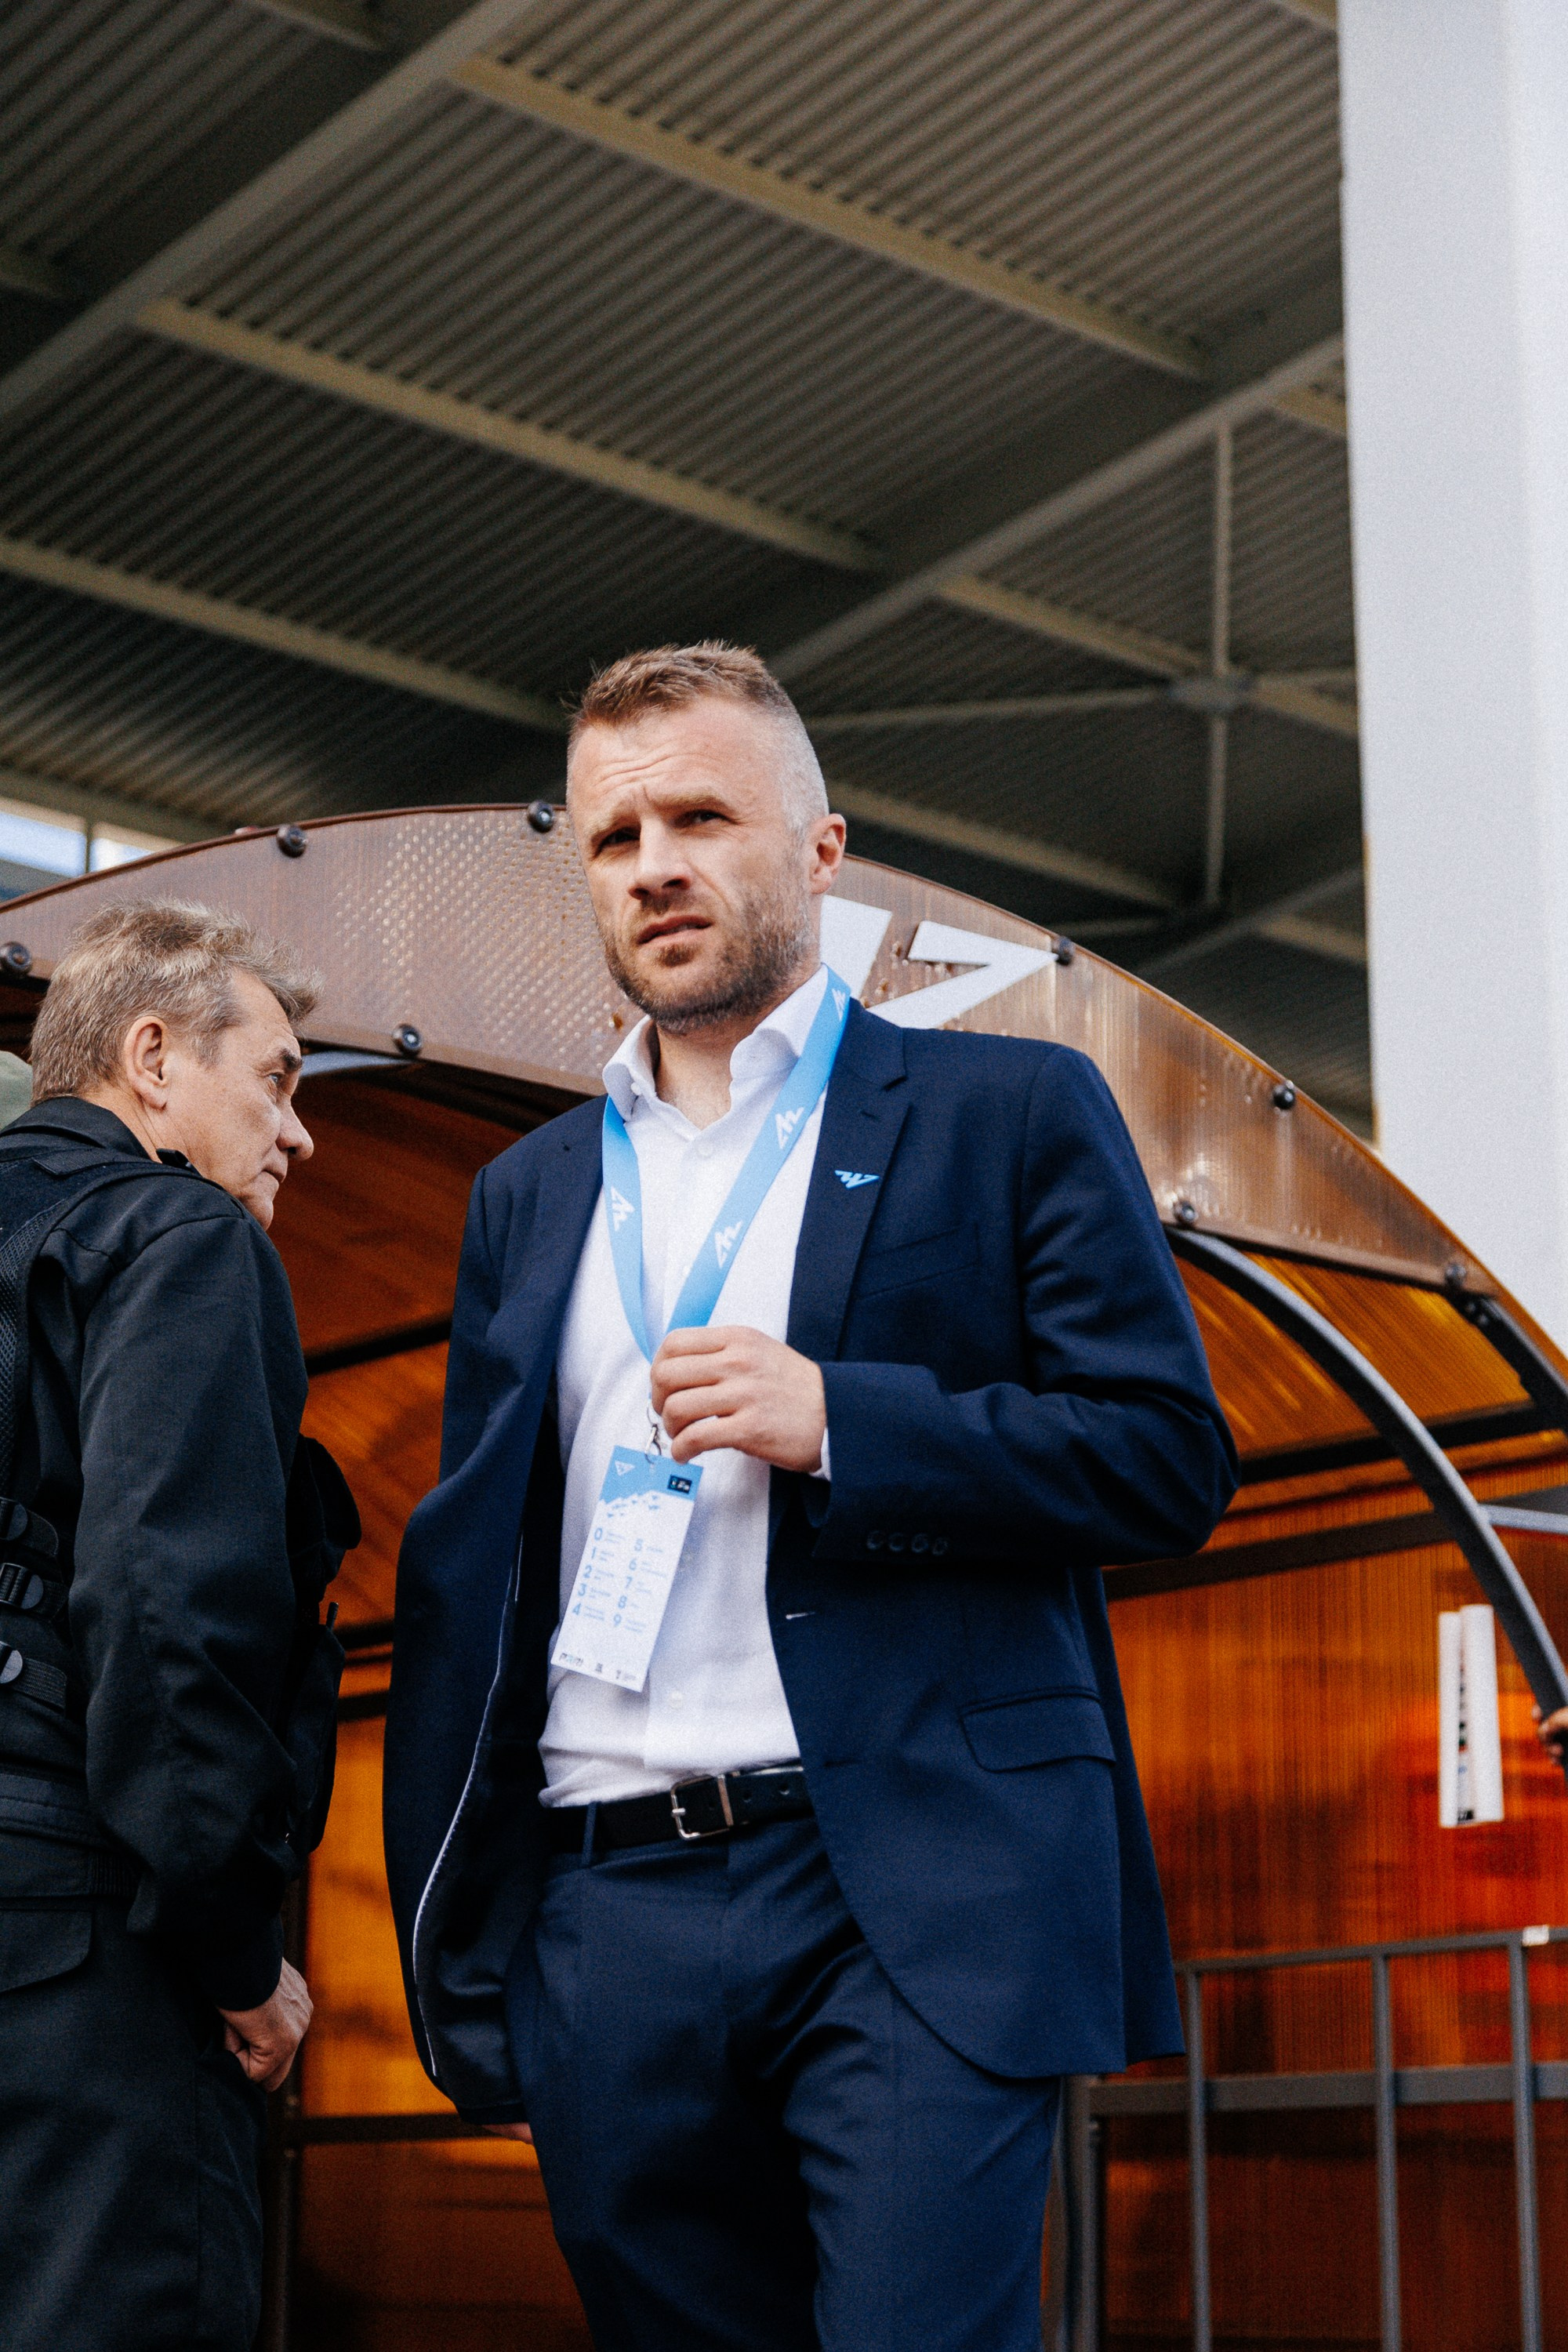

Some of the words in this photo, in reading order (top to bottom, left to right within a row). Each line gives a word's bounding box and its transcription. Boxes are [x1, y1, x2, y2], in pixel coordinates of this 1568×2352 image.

[593, 1527, 604, 1541] 0
[634, 1538, 644, 1552] 5
[591, 1546, 597, 1559] 1
[629, 1558, 637, 1571] 6
[583, 1565, 593, 1579] 2
[578, 1583, 587, 1596] 3
[625, 1576, 633, 1589] 7
[572, 1602, 582, 1616] 4
[618, 1595, 627, 1609] 8
[613, 1613, 622, 1627] 9
